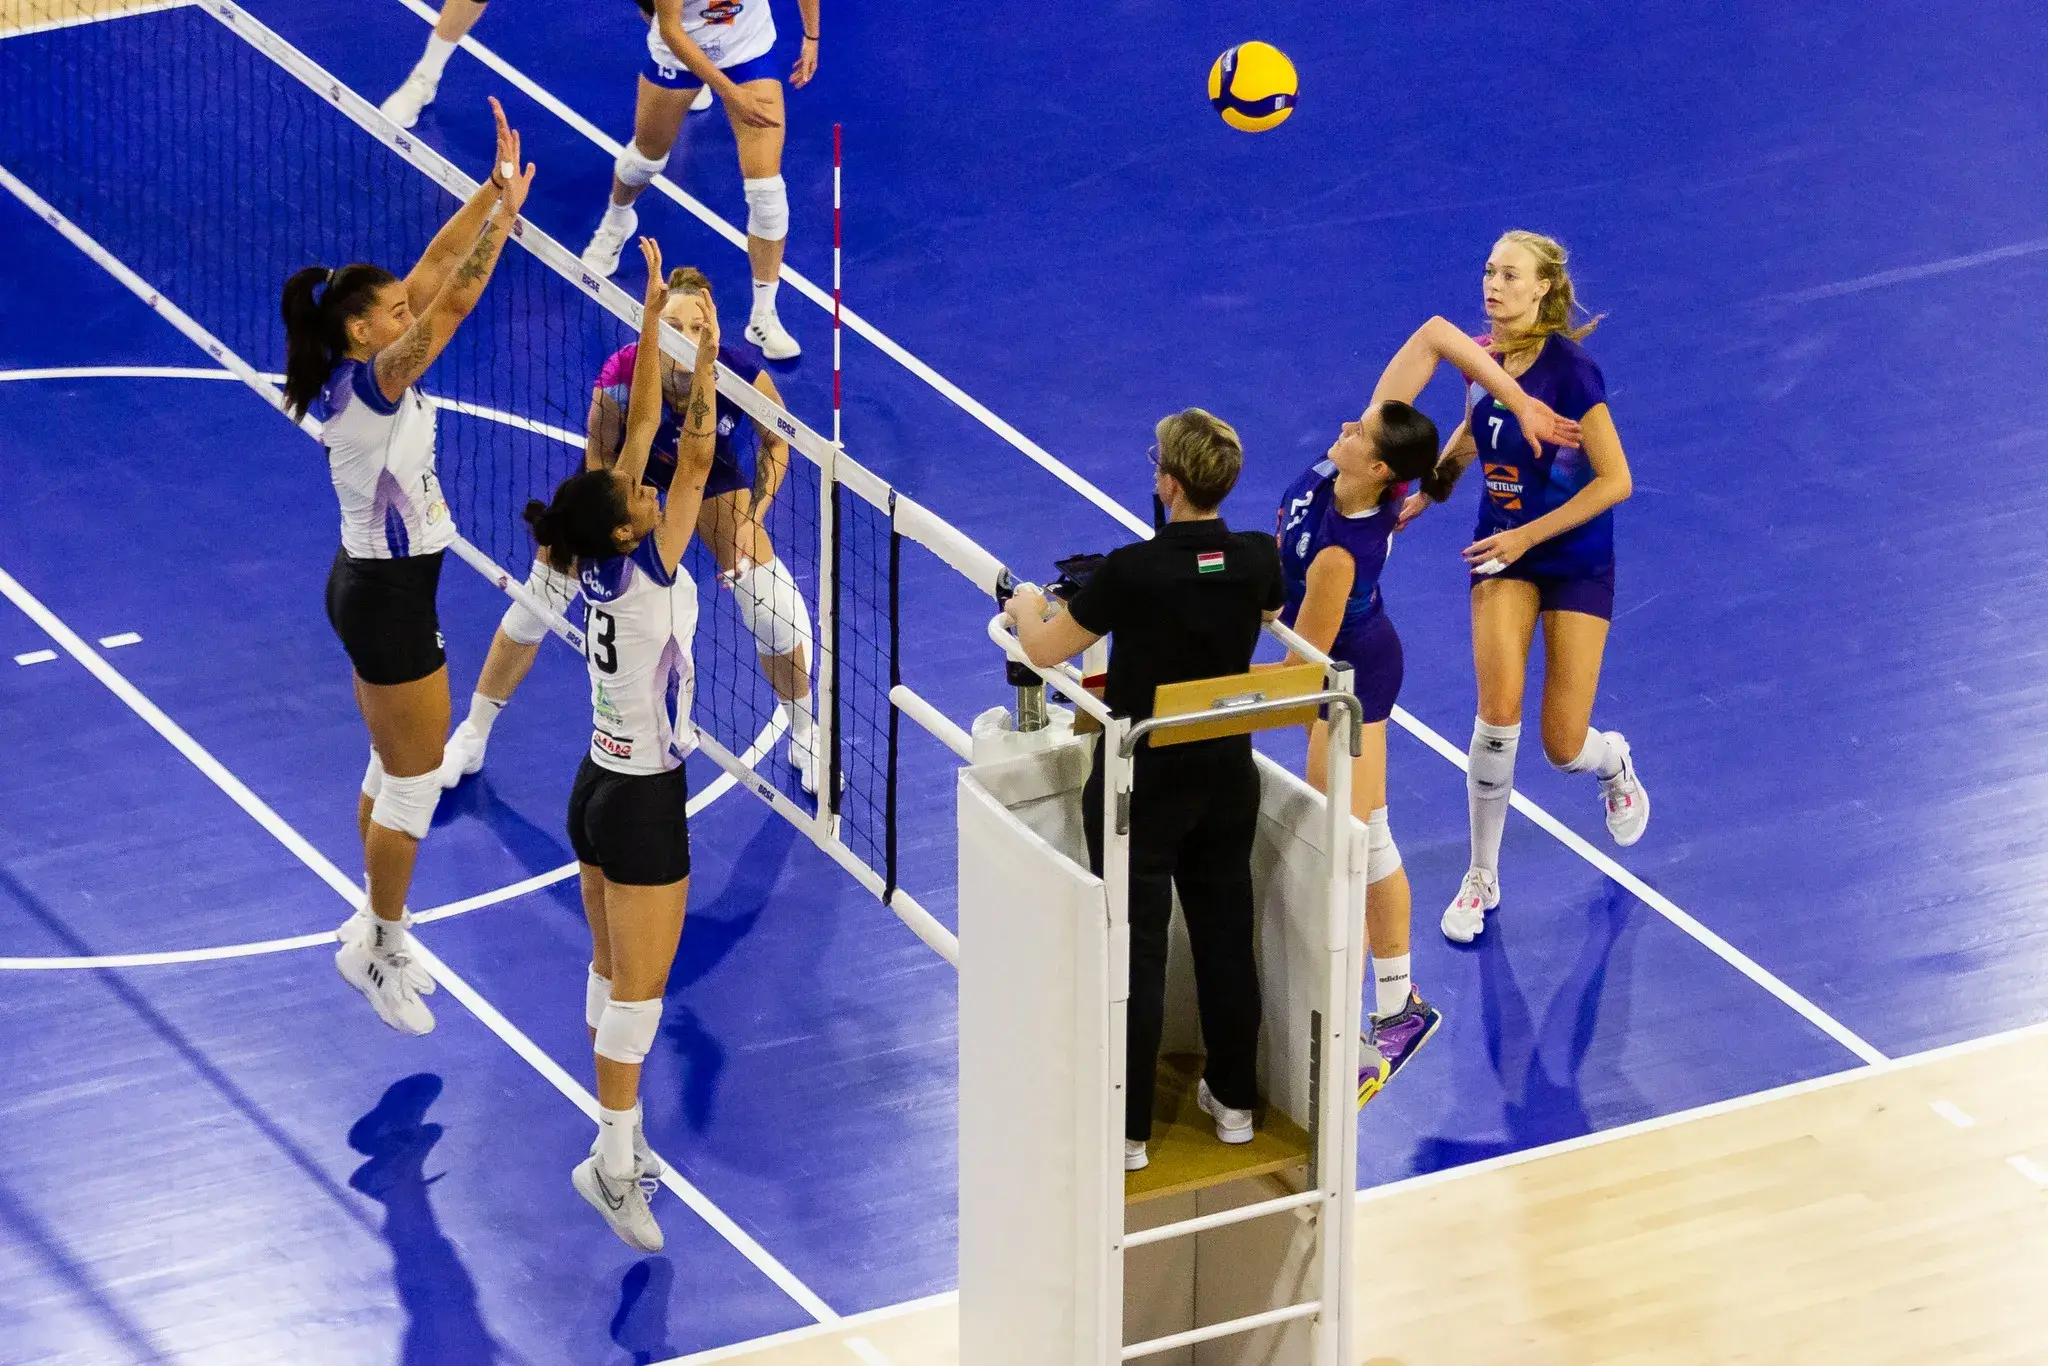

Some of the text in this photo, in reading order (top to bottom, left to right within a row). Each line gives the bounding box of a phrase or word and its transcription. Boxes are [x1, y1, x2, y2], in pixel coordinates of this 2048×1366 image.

[582, 273, 600, 293] BRSE
[777, 416, 796, 438] BRSE
[1488, 416, 1503, 449] 7
[585, 603, 618, 675] 13
[758, 784, 775, 802] BRSE
